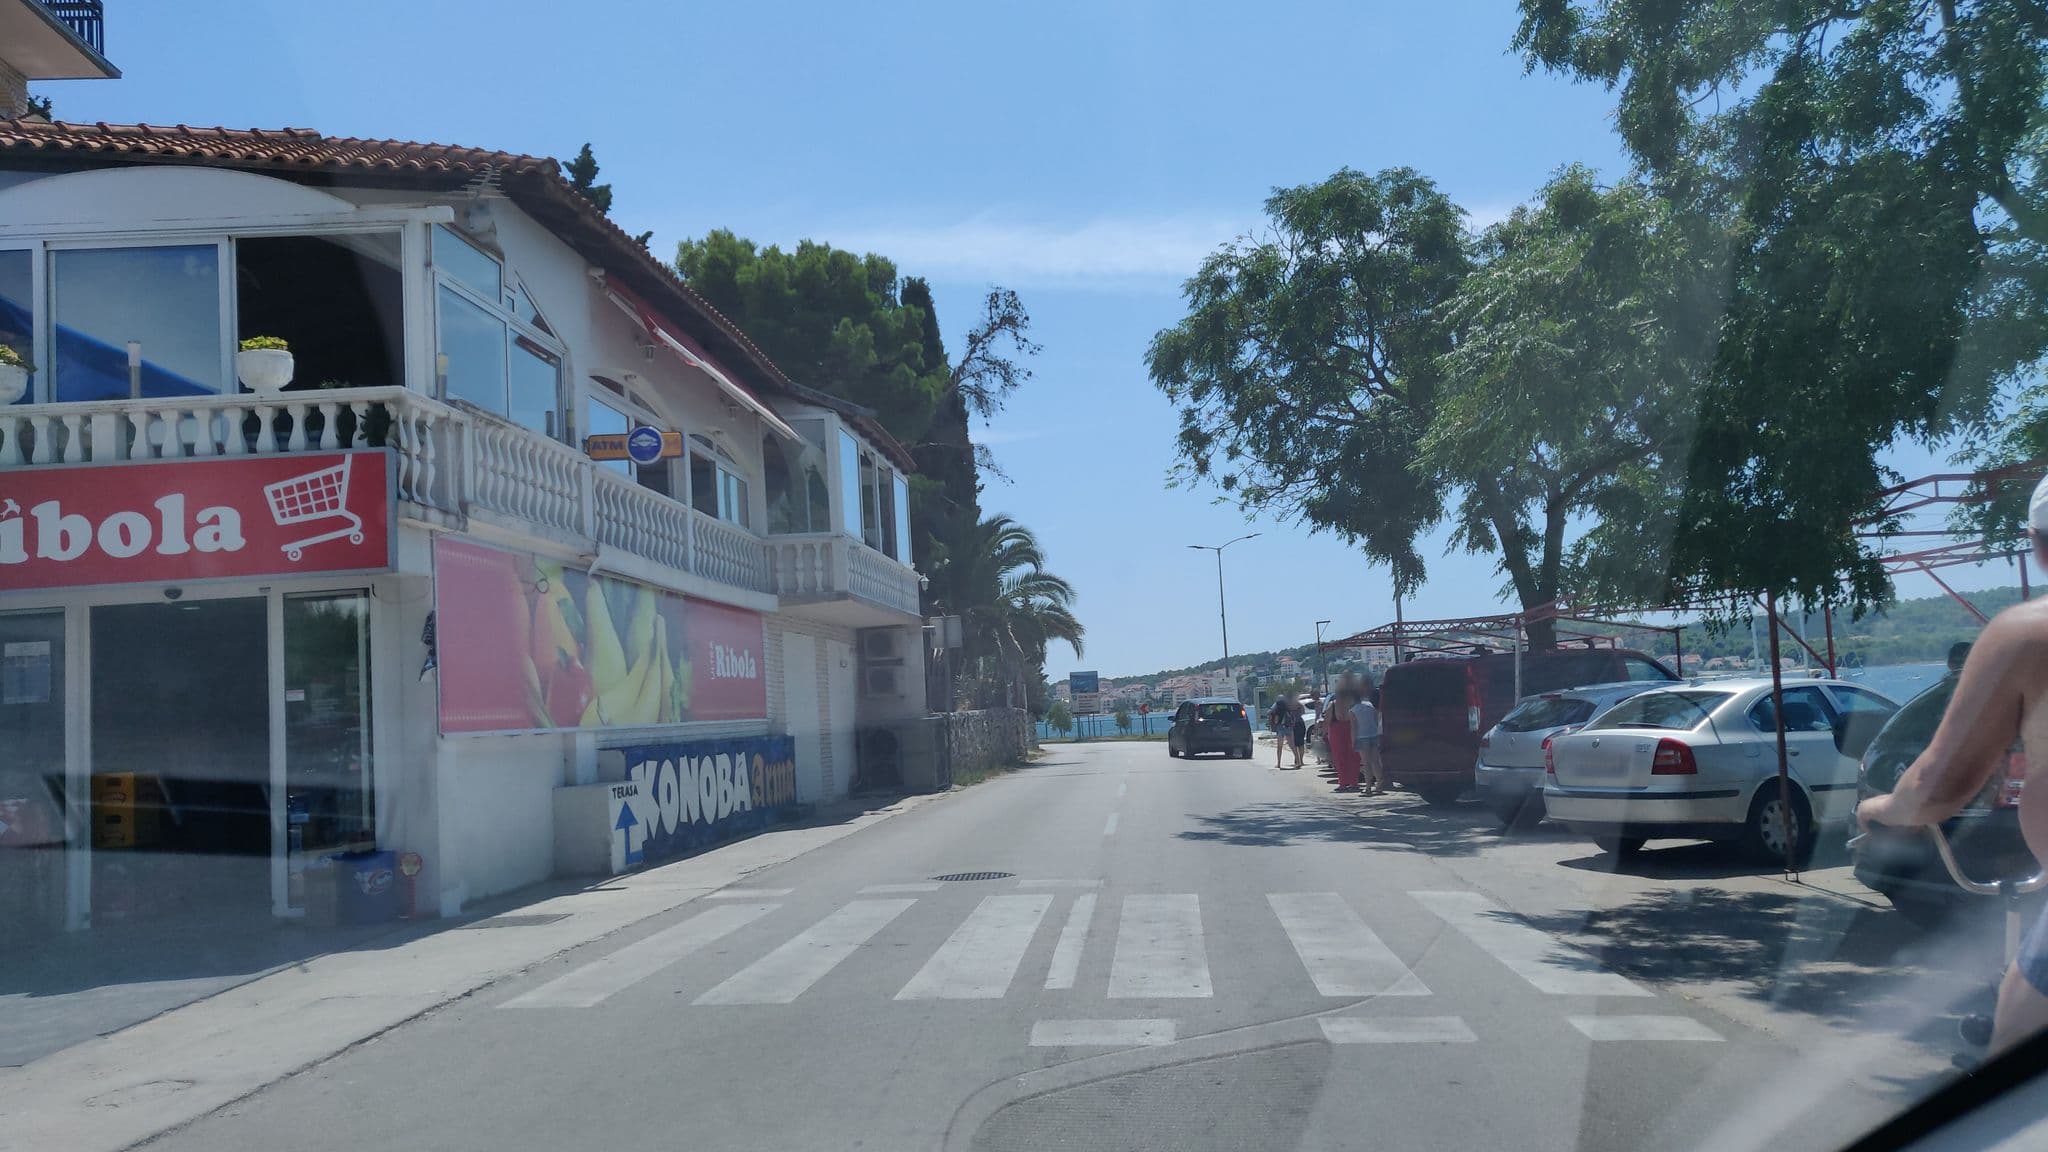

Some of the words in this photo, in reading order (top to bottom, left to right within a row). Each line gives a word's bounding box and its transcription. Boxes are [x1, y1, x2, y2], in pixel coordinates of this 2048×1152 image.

[592, 441, 624, 450] ATM
[715, 645, 756, 679] Ribola
[612, 785, 639, 799] TERASA
[631, 752, 752, 839] KONOBA
